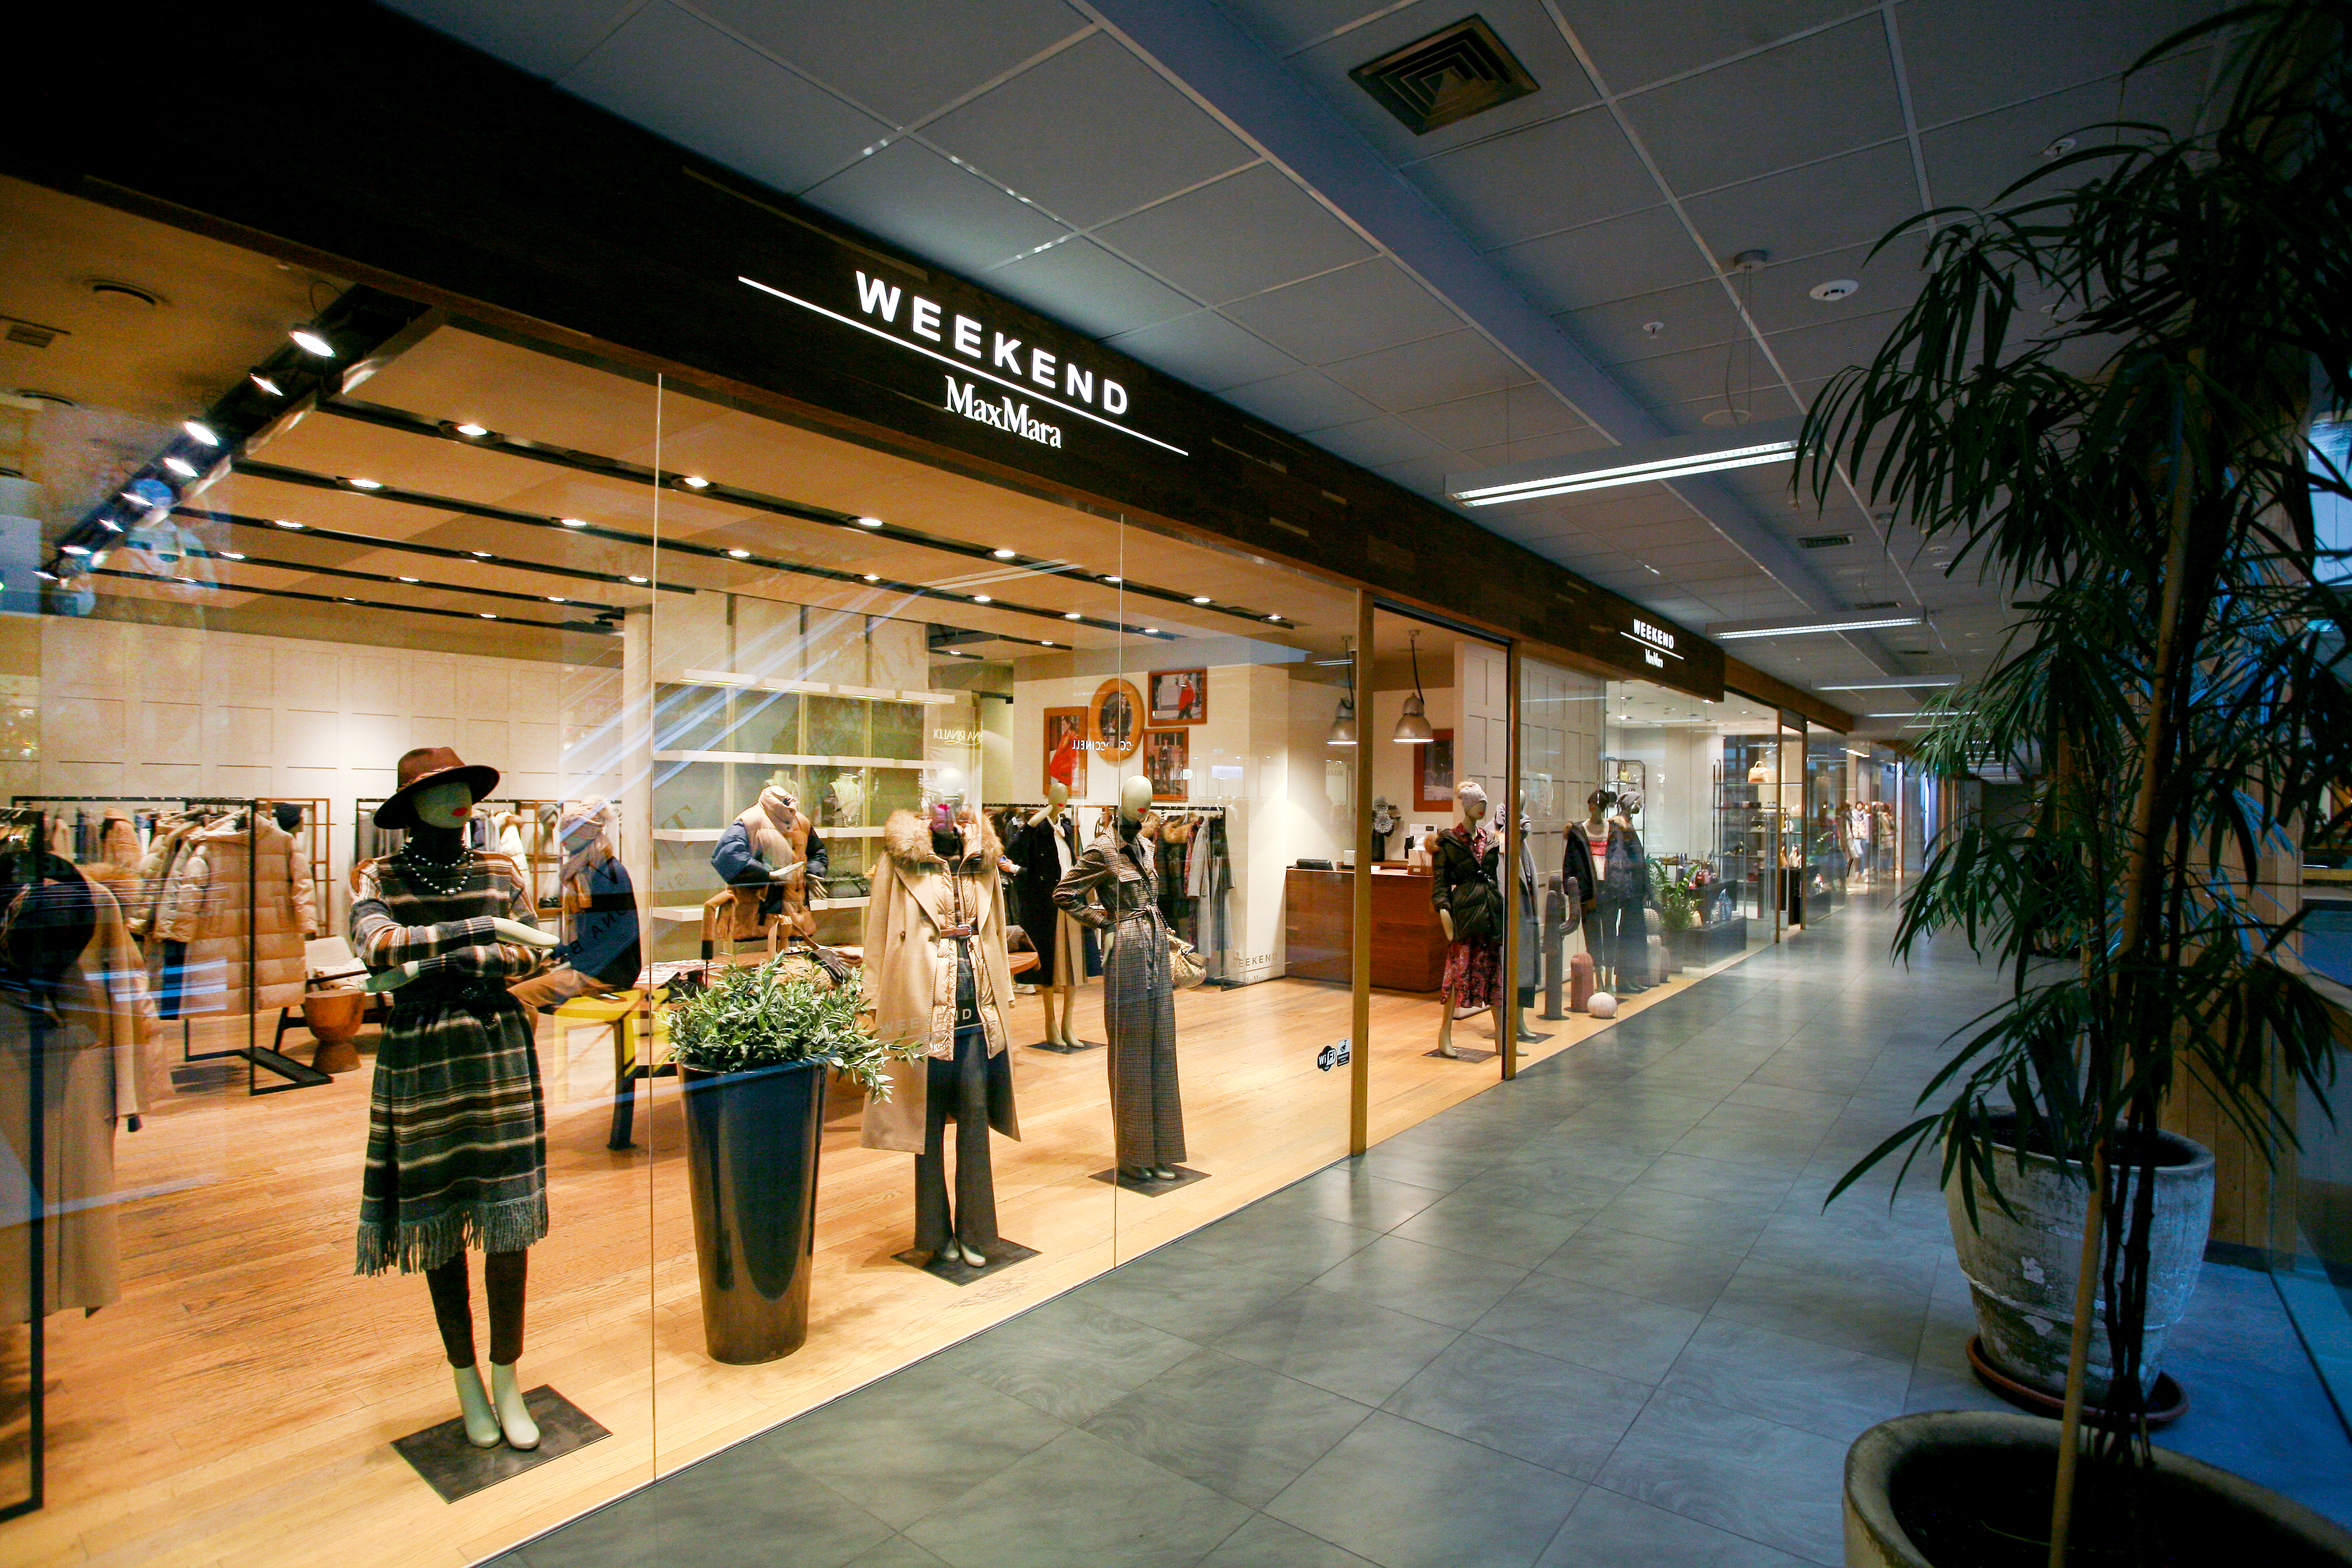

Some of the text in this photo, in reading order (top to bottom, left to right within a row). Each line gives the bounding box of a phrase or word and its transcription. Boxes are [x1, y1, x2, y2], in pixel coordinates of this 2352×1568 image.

[855, 270, 1129, 415] WEEKEND
[944, 375, 1062, 449] MaxMara
[1633, 618, 1675, 649] WEEKEND
